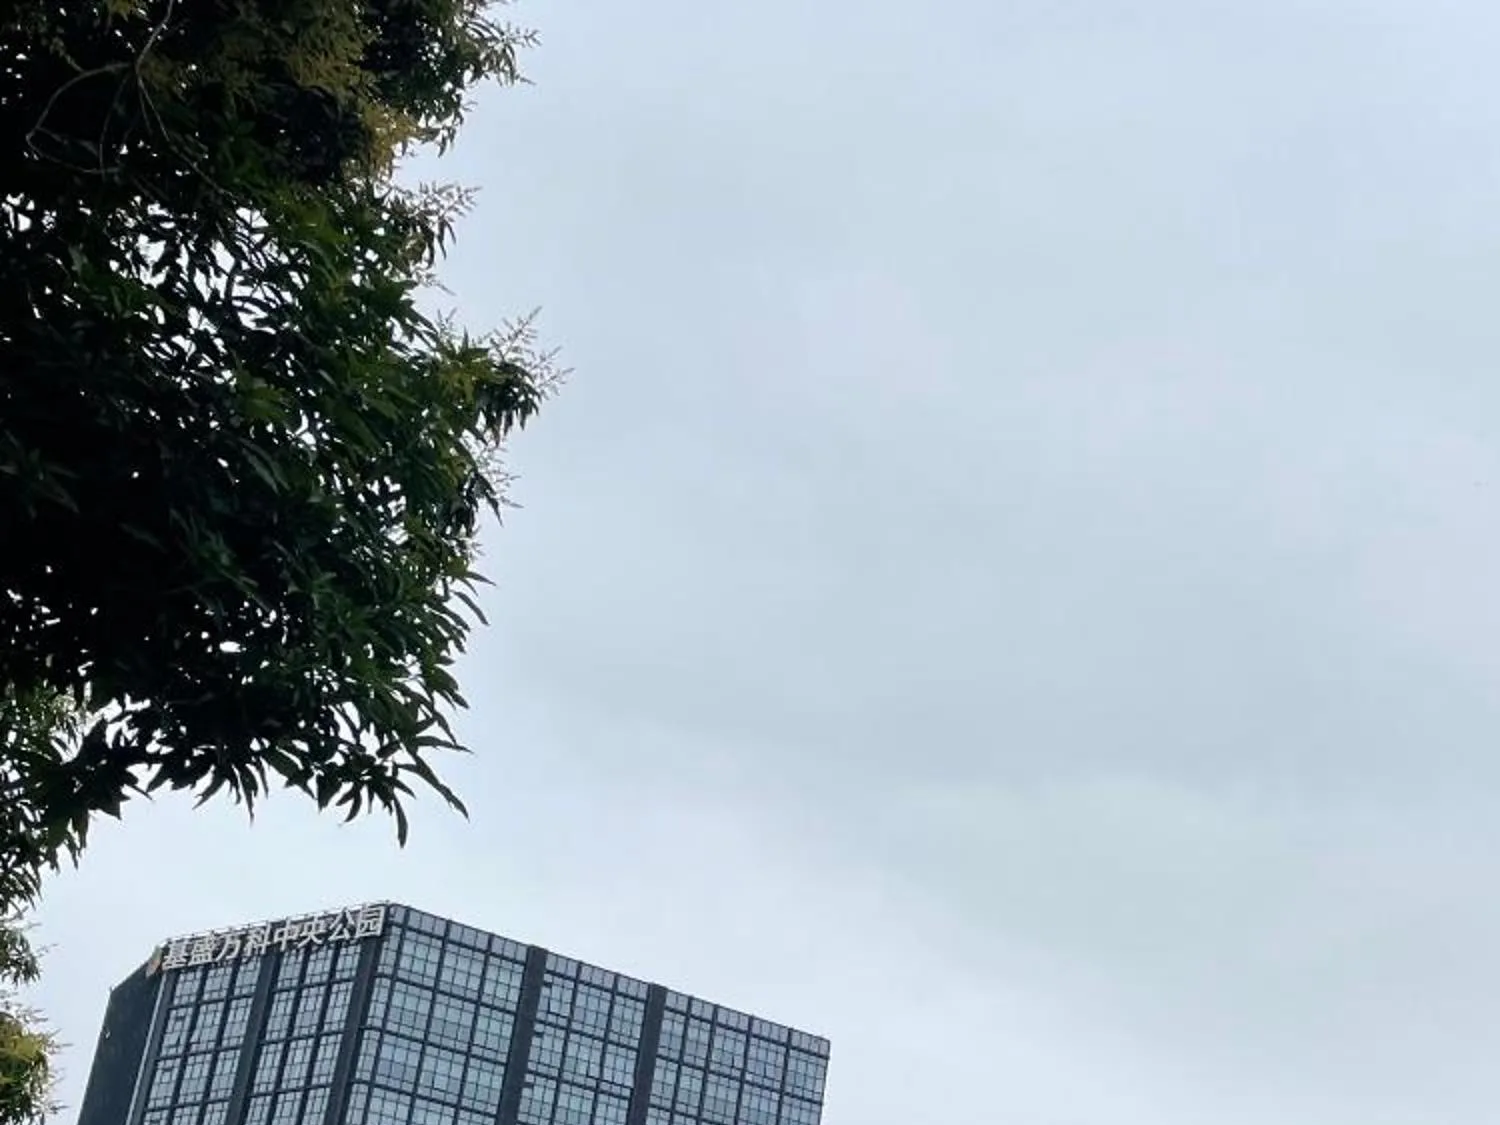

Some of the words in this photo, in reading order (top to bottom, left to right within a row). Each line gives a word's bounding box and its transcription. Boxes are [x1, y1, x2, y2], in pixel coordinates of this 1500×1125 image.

[161, 905, 386, 970] 基盛万科中央公园
